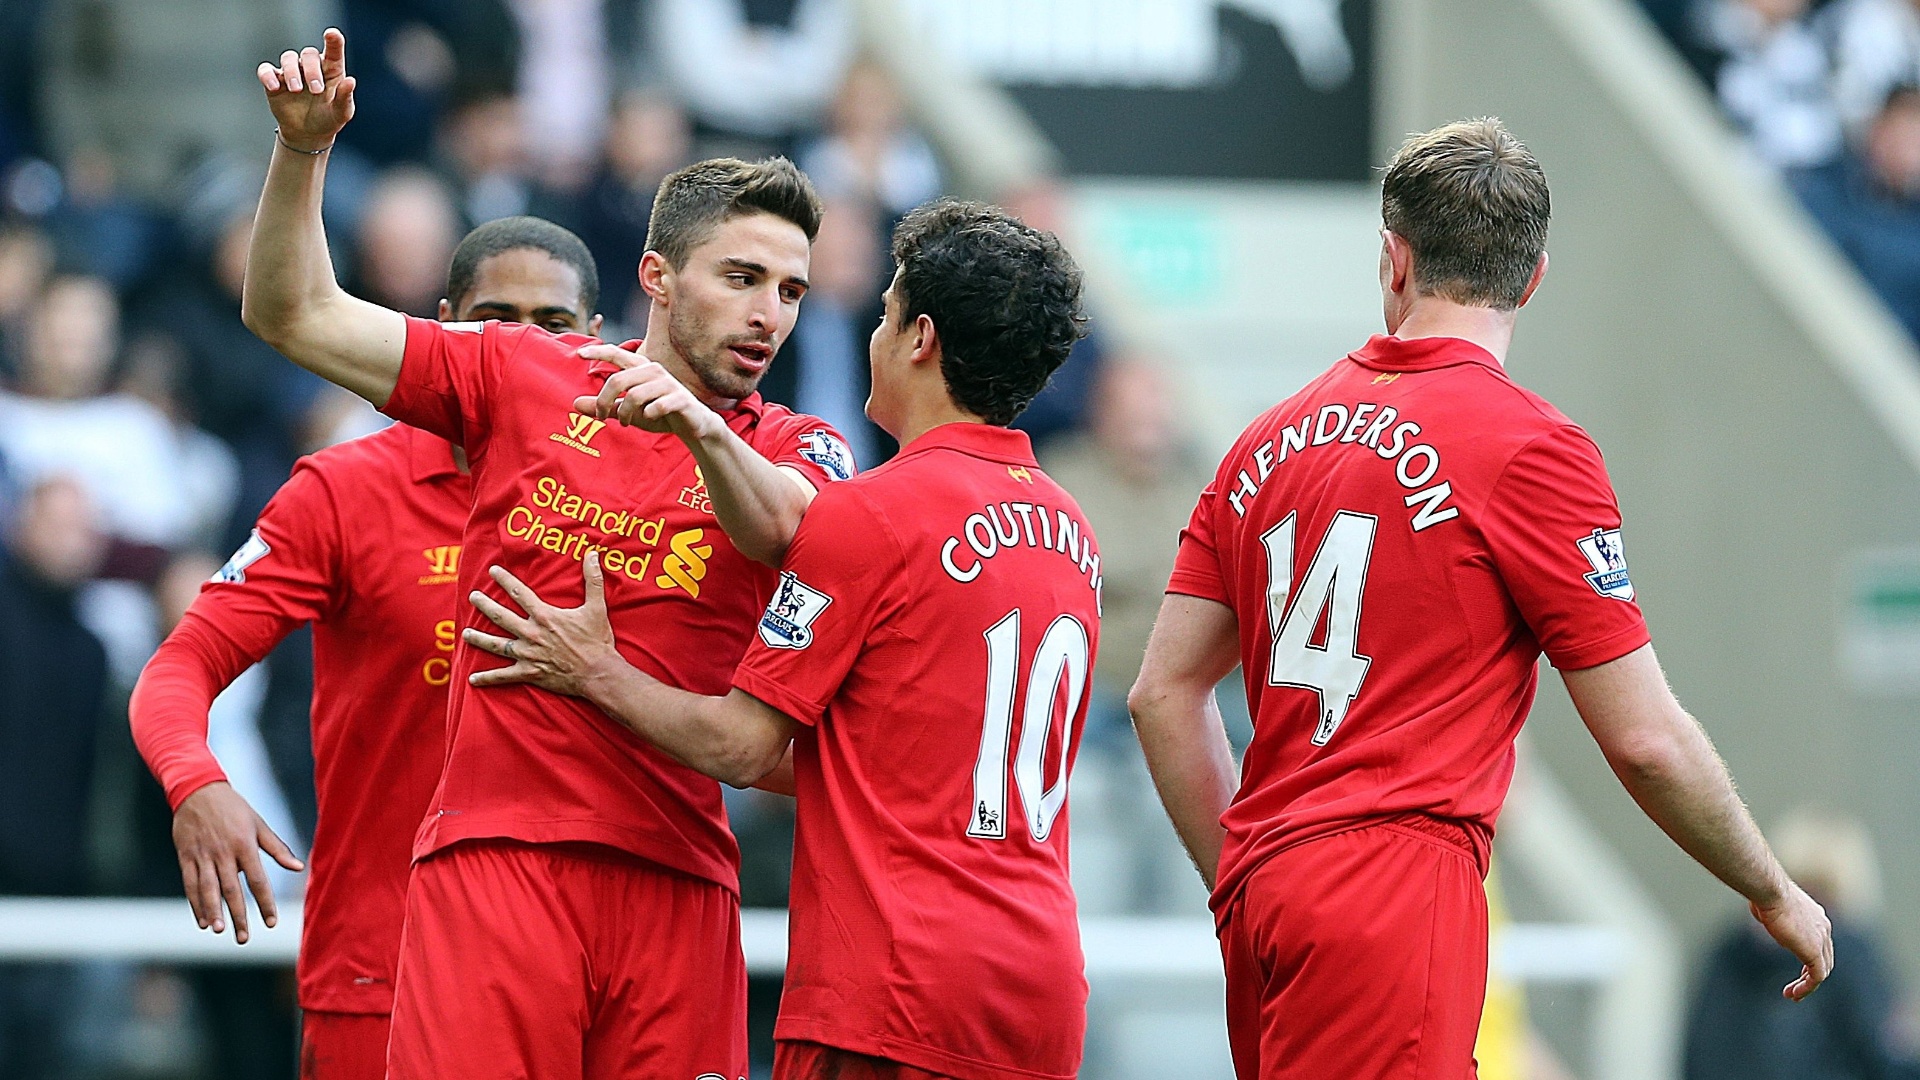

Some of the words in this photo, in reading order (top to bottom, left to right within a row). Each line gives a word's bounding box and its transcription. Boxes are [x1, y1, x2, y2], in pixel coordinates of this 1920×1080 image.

[531, 476, 666, 547] Standard
[1228, 402, 1459, 532] HENDERSON
[1259, 509, 1379, 746] 14
[965, 606, 1090, 843] 10
